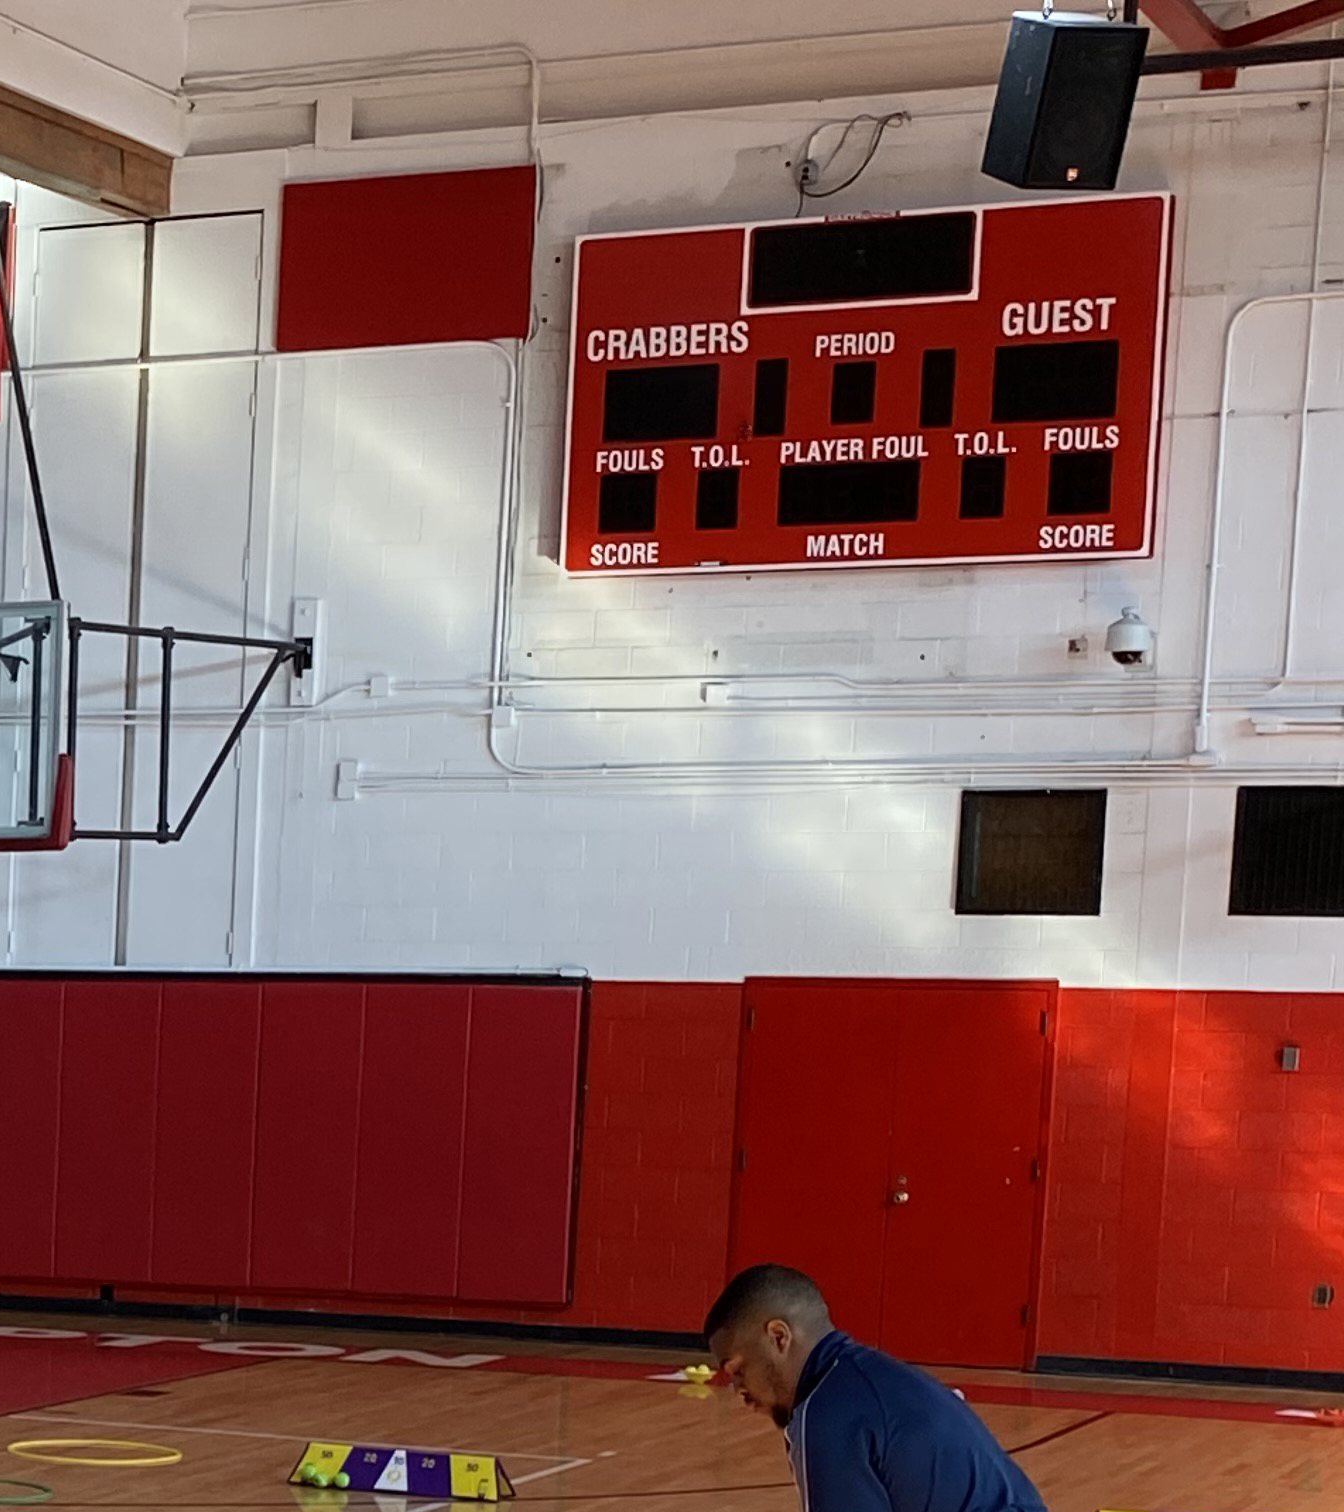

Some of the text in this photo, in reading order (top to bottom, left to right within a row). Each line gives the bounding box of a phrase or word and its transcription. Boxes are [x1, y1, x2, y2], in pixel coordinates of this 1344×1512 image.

[1001, 297, 1117, 337] GUEST
[586, 320, 749, 362] CRABBERS
[815, 331, 896, 358] PERIOD
[779, 435, 930, 465] PLAYER FOUL
[954, 431, 1017, 456] T.O.L.
[1044, 425, 1120, 451] FOULS
[595, 448, 664, 473] FOULS
[691, 444, 750, 469] T.O.L.
[805, 533, 885, 558] MATCH
[1039, 524, 1115, 549] SCORE
[590, 541, 659, 567] SCORE
[363, 1452, 378, 1464] 20
[421, 1457, 436, 1469] 20
